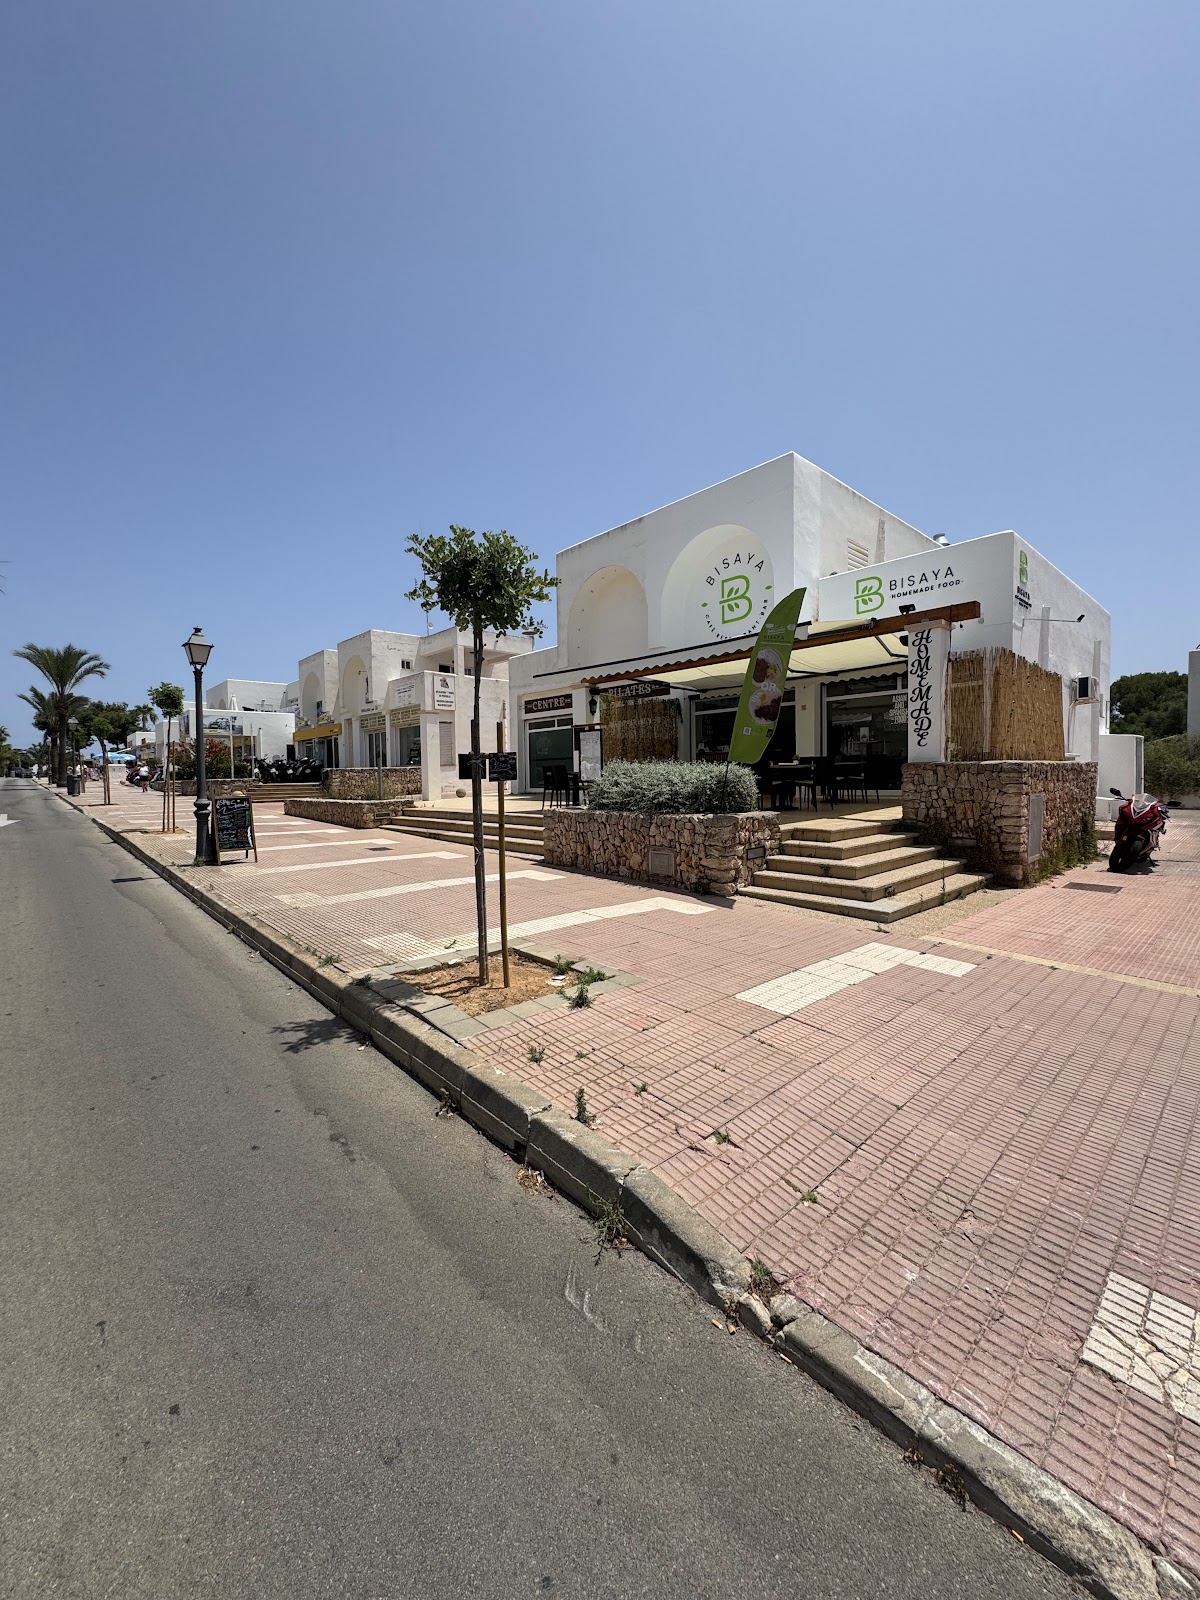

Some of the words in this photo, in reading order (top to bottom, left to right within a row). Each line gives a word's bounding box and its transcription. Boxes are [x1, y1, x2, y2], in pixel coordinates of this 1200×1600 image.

[706, 552, 764, 586] BISAYA
[889, 567, 954, 591] BISAYA
[608, 683, 652, 697] PILATES
[761, 681, 776, 692] OR
[909, 628, 933, 747] HOMEMADE
[532, 697, 566, 711] CENTRE
[892, 694, 908, 703] ASIAN
[894, 701, 905, 709] AND
